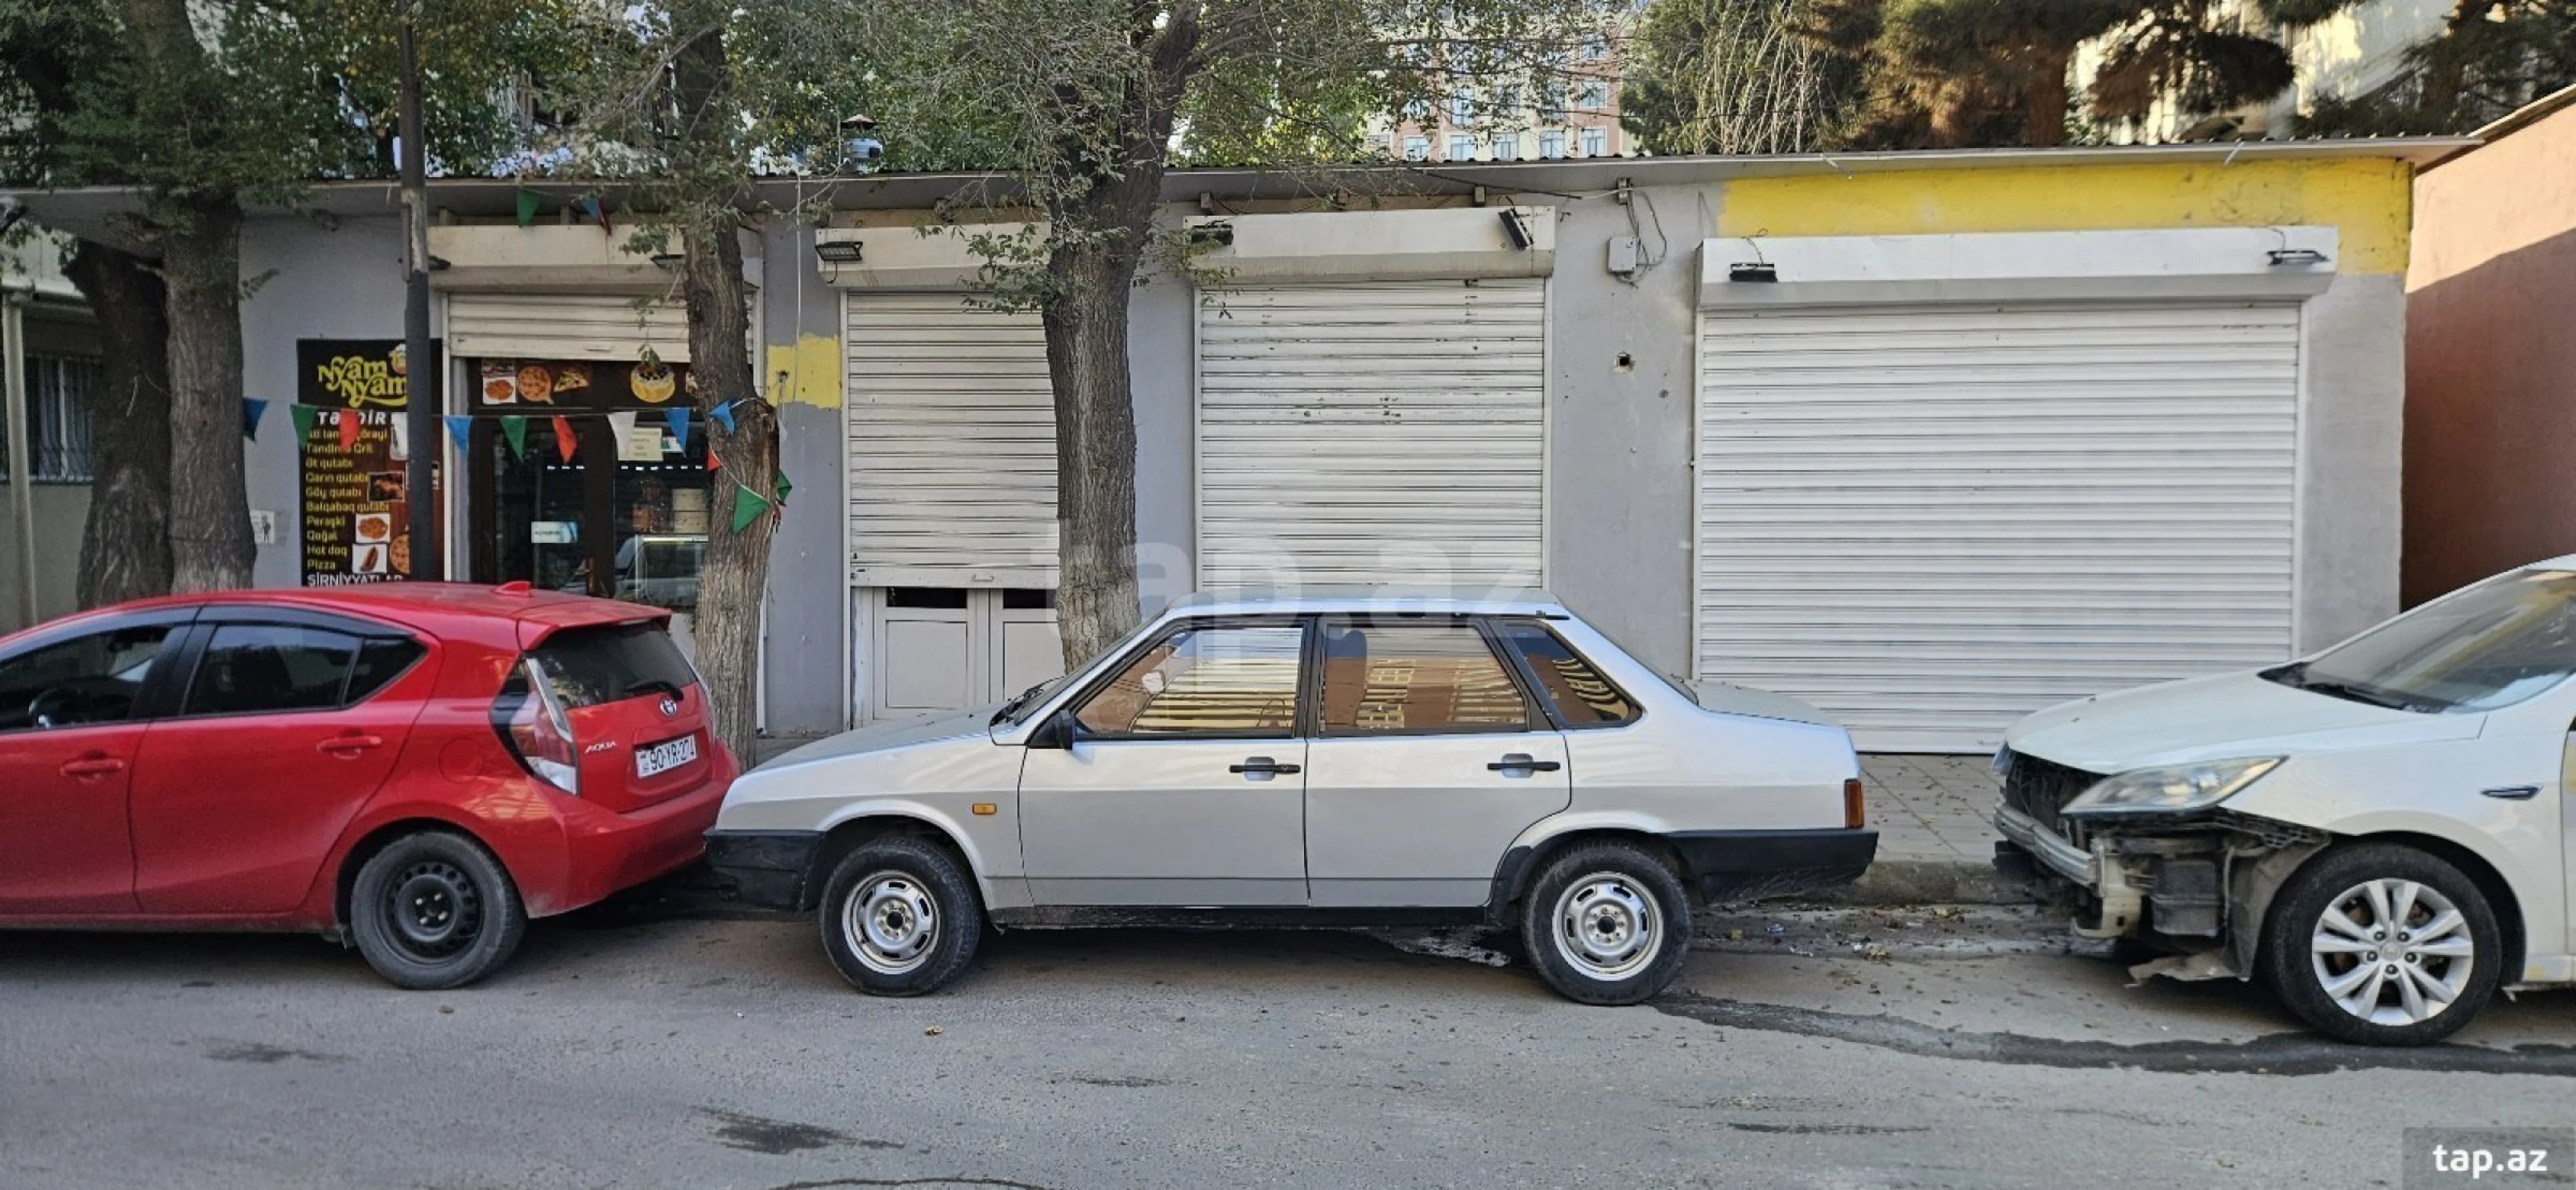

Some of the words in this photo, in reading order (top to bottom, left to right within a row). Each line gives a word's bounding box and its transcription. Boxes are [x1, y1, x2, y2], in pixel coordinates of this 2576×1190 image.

[318, 356, 387, 391] Nyam
[317, 409, 386, 425] TƏDİR
[307, 544, 326, 556] Hot
[307, 559, 335, 570] Pizza
